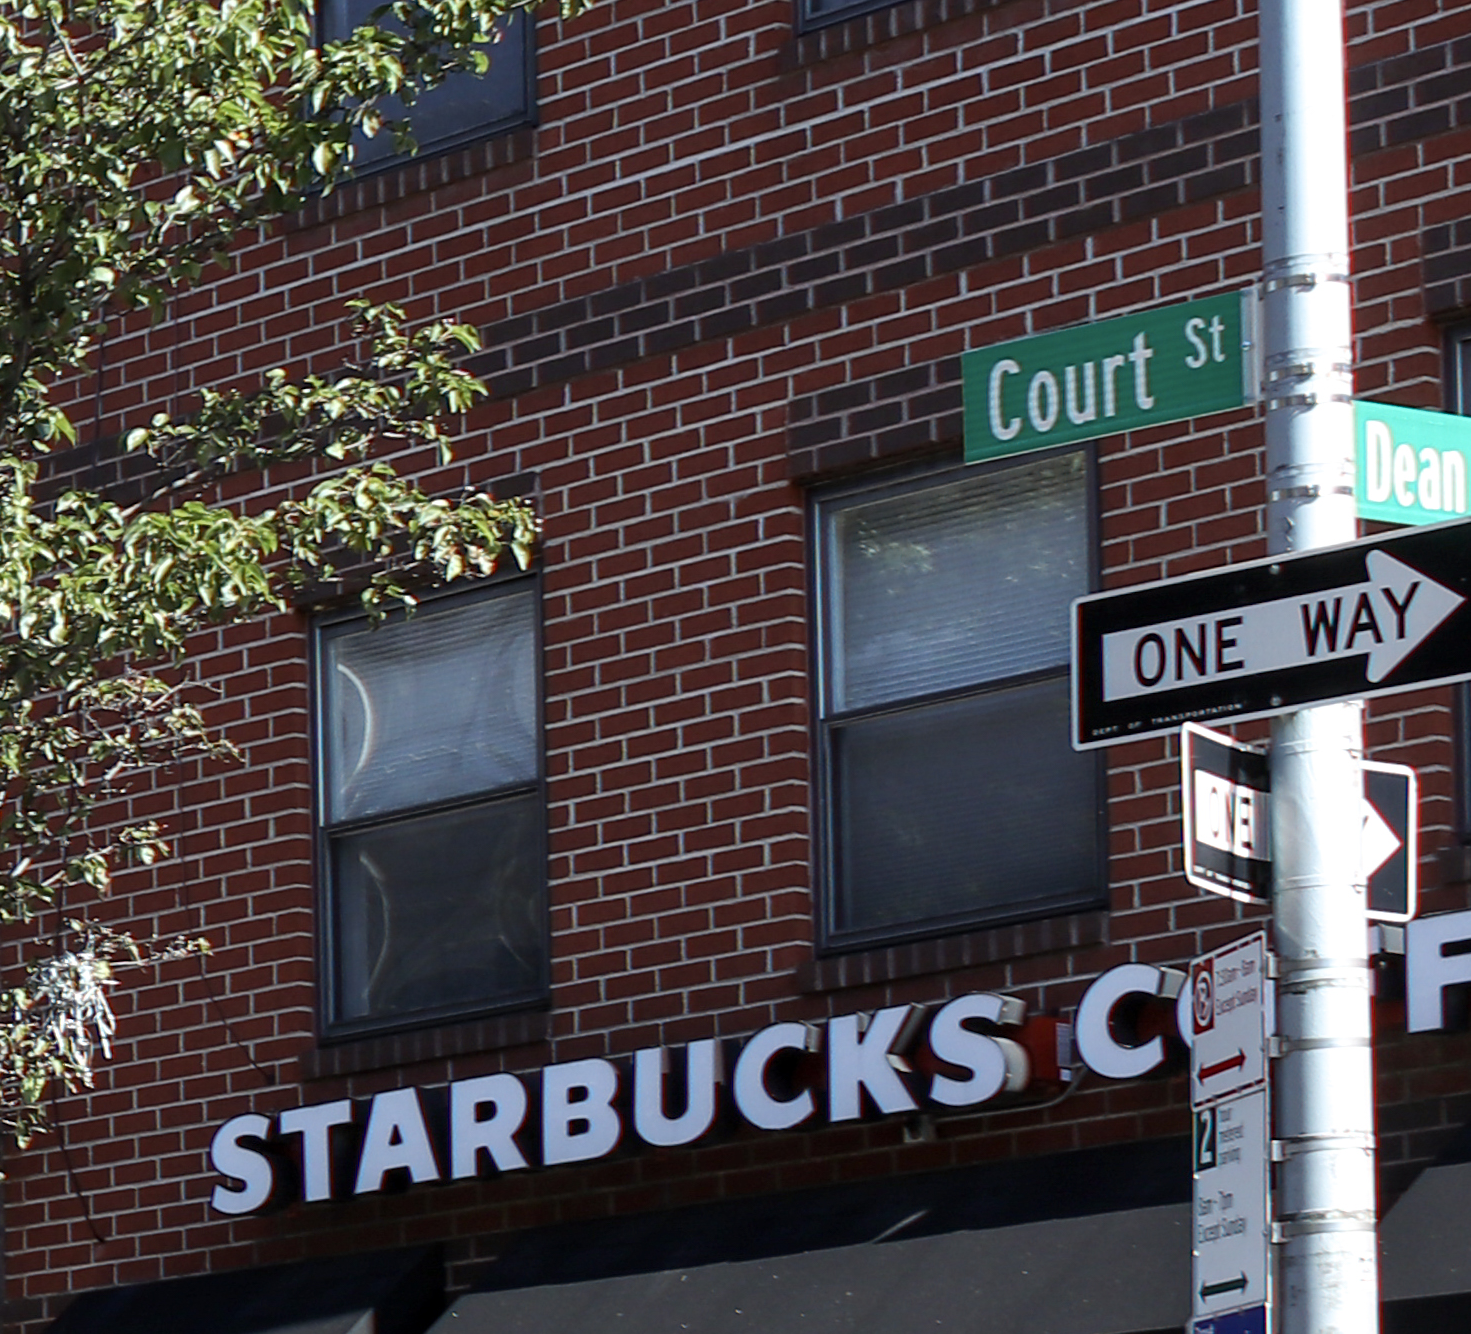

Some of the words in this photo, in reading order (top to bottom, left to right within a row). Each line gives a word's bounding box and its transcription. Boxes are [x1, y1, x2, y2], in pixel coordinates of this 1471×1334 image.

[988, 331, 1155, 441] Court
[1184, 315, 1226, 369] St
[1366, 419, 1467, 514] Dean
[1134, 616, 1245, 687] ONE
[1300, 581, 1421, 657] WAY
[1151, 702, 1244, 725] TRANSPORTATION
[1209, 786, 1253, 851] ONE
[210, 992, 1007, 1216] STARBUCKS
[1074, 911, 1471, 1079] CF
[1199, 1110, 1213, 1164] 2
